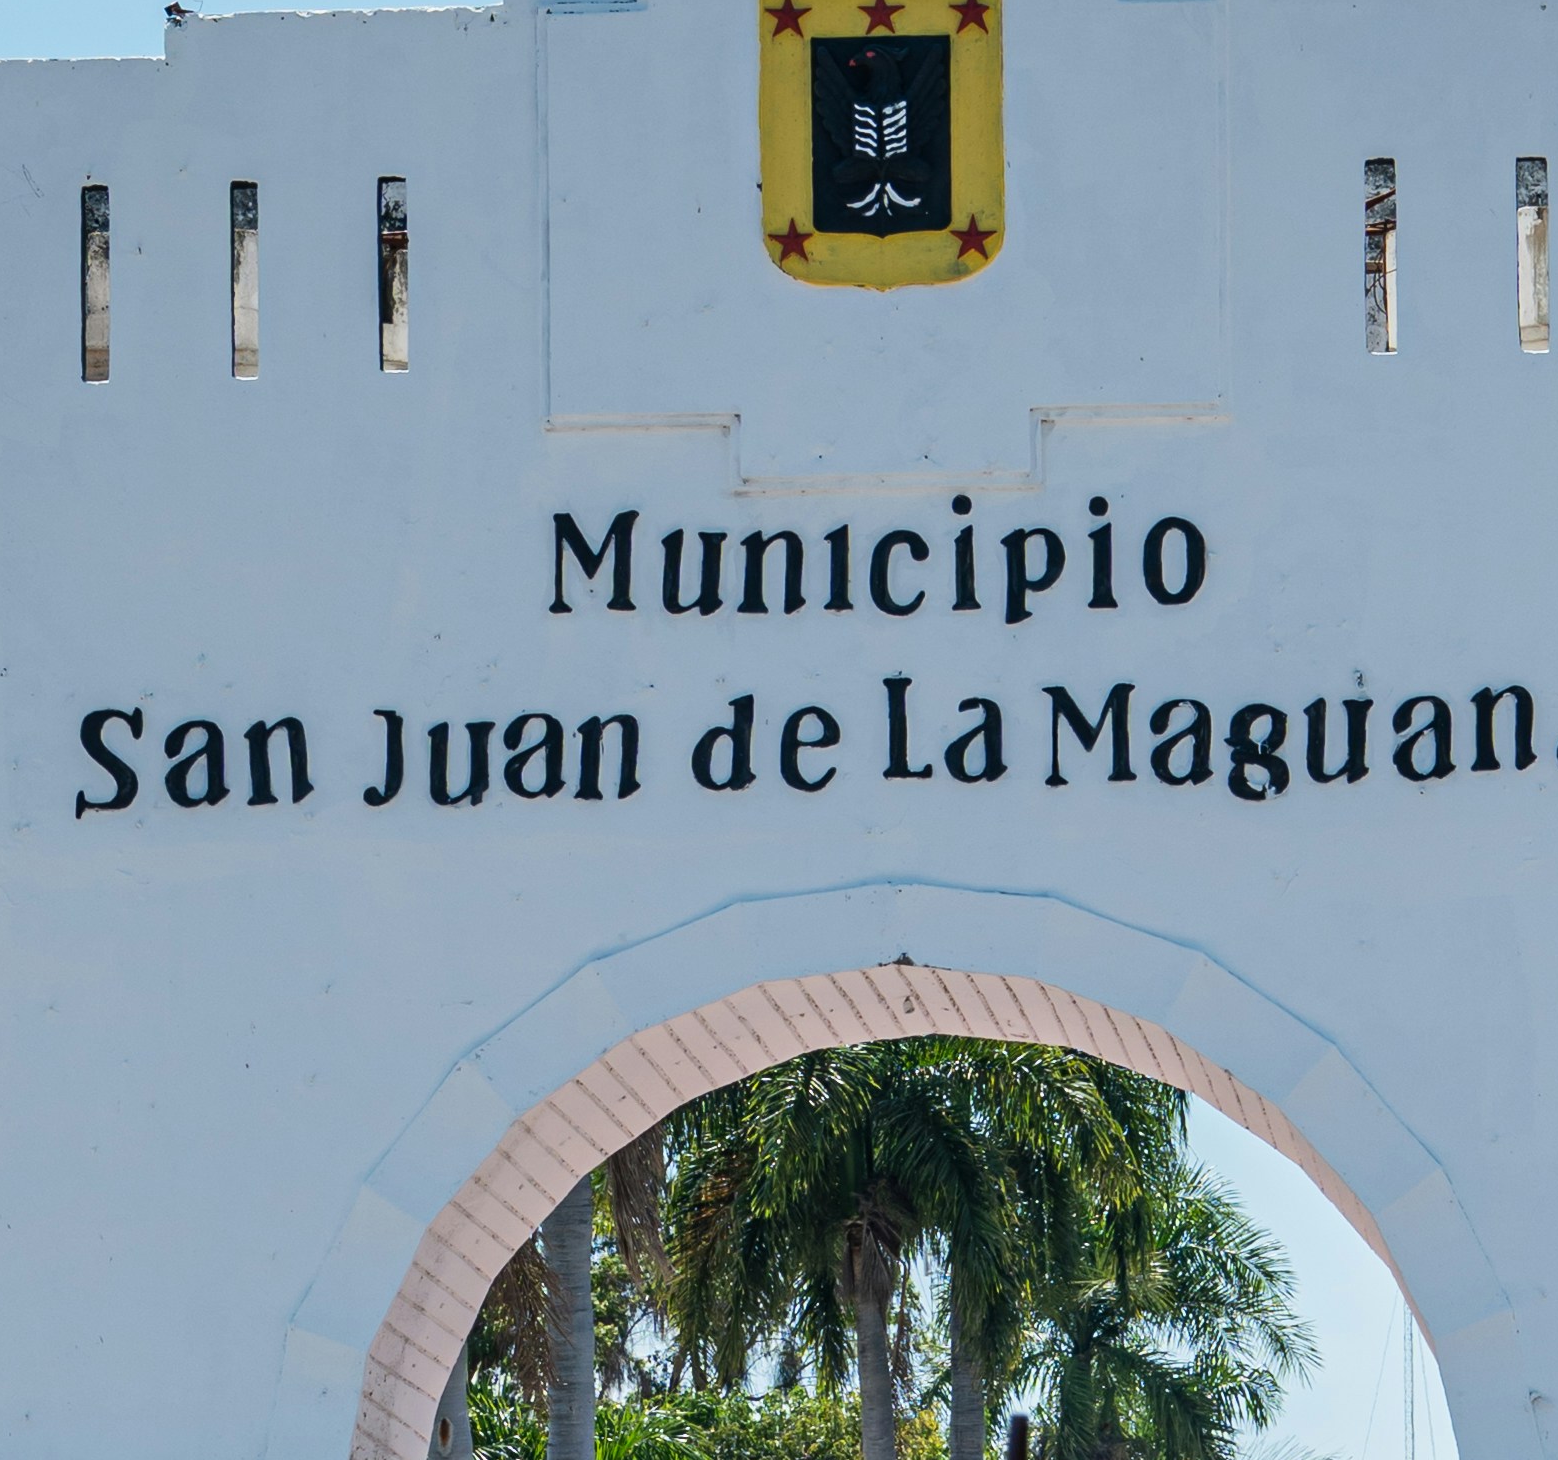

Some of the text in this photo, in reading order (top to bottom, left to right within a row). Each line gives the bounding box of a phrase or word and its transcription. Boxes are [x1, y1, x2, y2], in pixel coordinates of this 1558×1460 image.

[548, 494, 1206, 625] Municipio
[74, 706, 315, 820] San
[363, 709, 641, 808] Juan
[691, 693, 841, 793] de
[881, 676, 1008, 784] La
